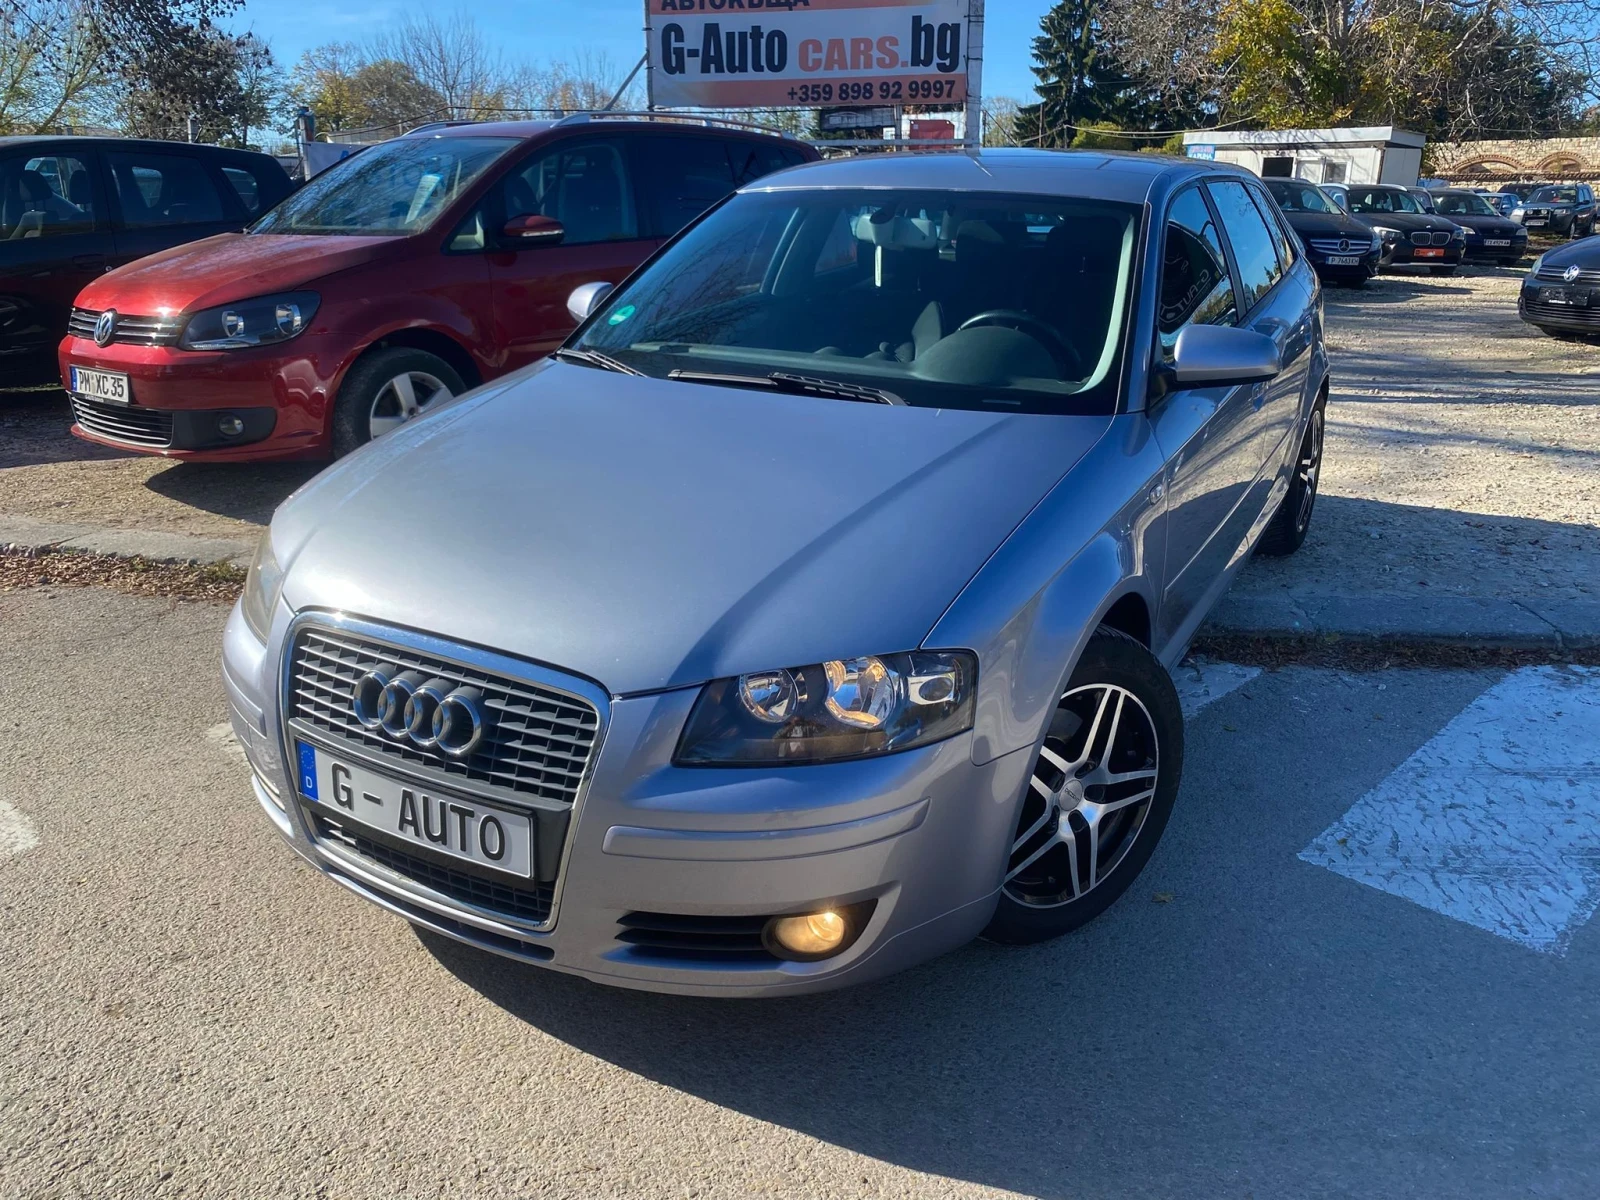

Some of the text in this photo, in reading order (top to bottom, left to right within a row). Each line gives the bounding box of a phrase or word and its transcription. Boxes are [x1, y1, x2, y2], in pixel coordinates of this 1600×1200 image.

[661, 22, 788, 75] G-Auto
[787, 80, 956, 102] +359 898 92 9997
[79, 371, 124, 398] PM XC 35
[398, 787, 506, 862] AUTO
